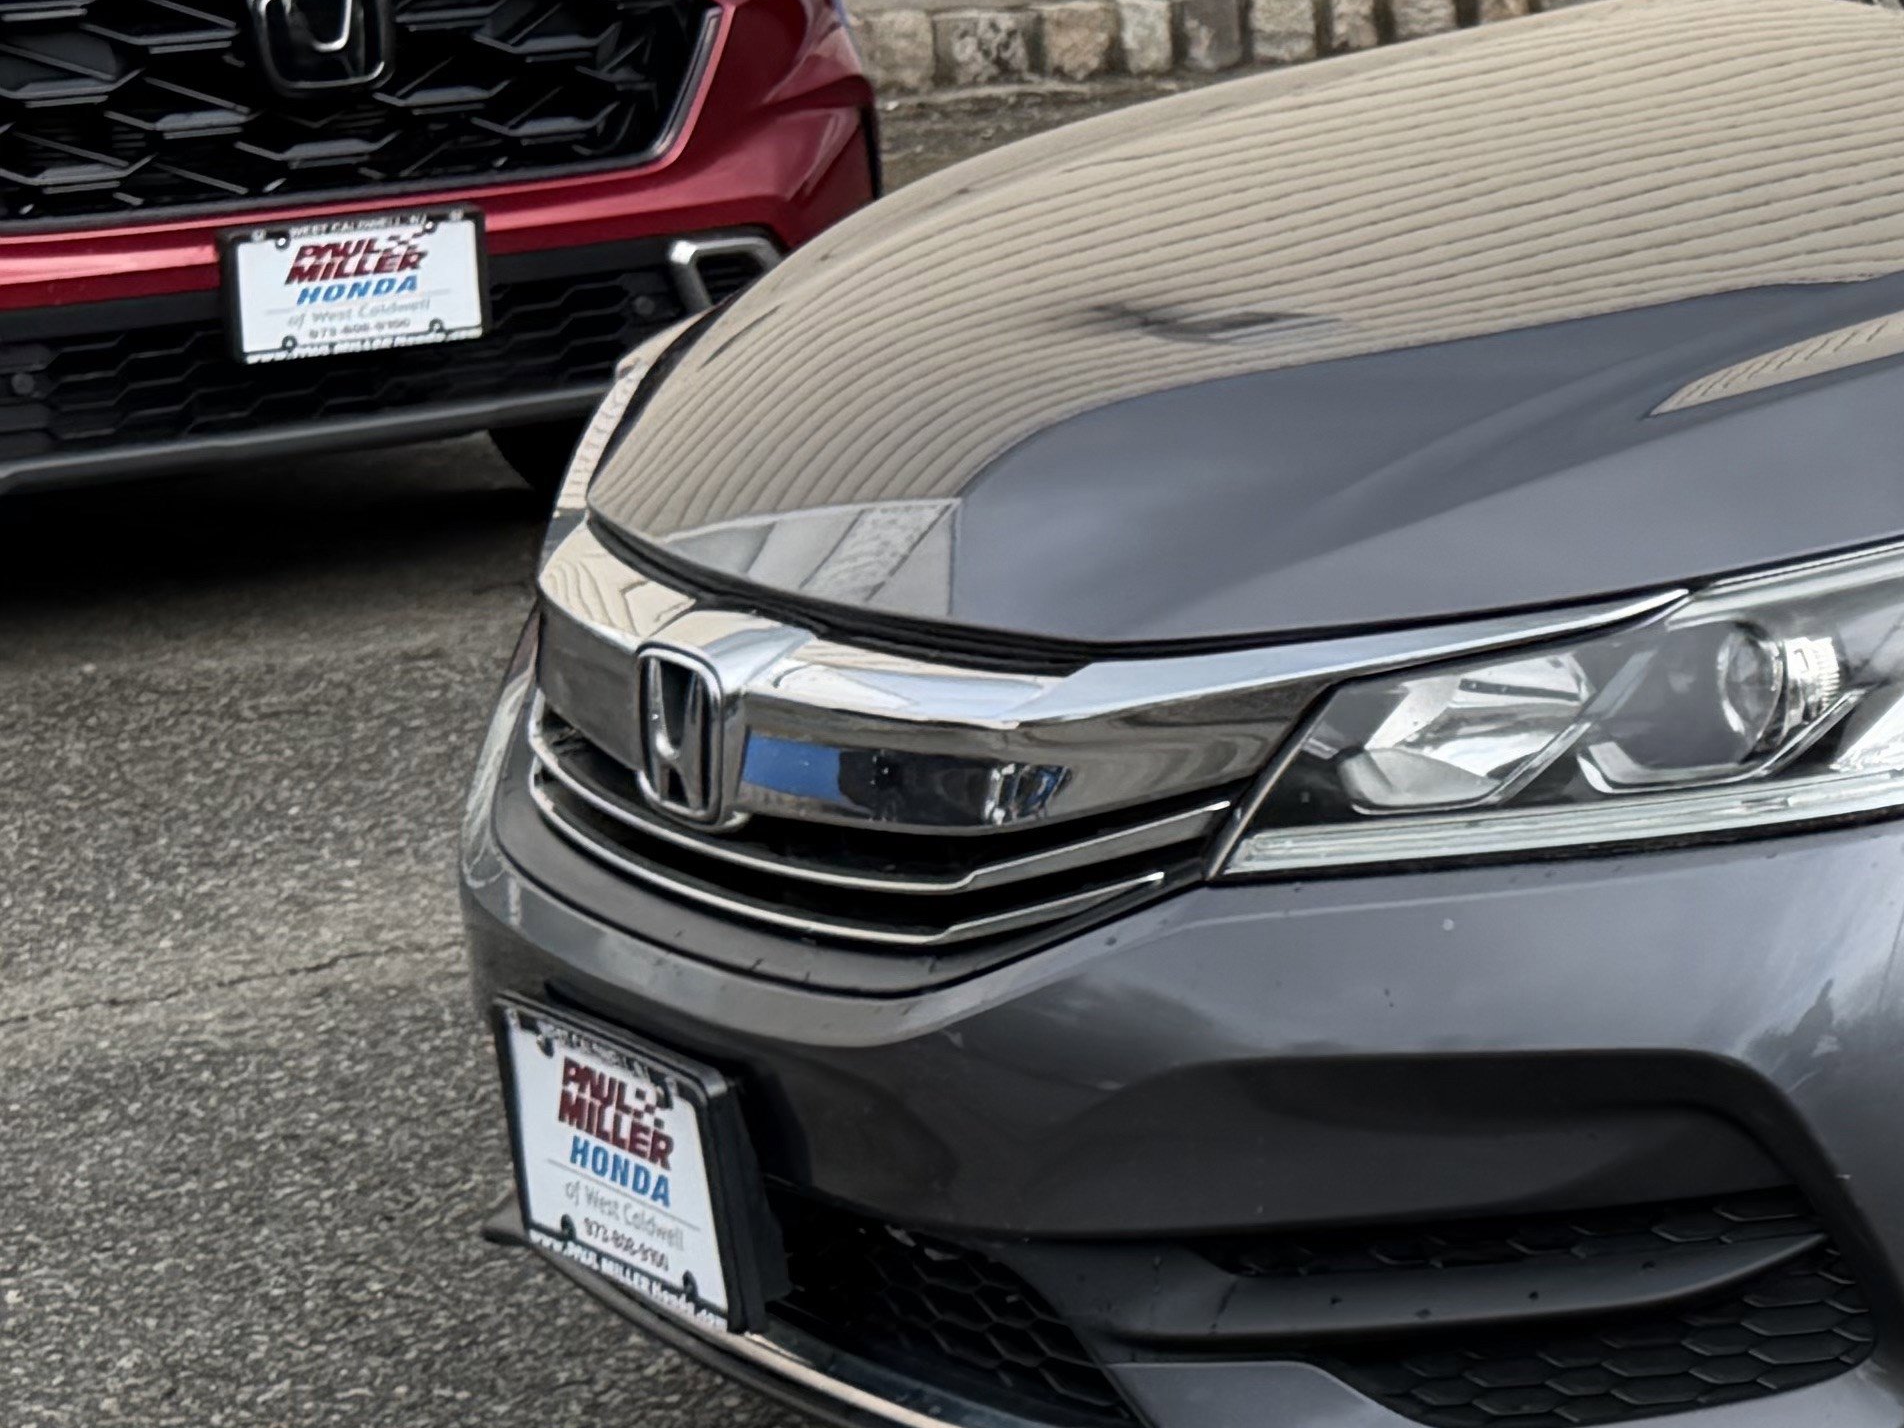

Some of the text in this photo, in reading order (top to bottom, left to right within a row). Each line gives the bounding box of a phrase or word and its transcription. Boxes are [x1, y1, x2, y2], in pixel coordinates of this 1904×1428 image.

[285, 245, 428, 285] MILLER
[296, 238, 380, 264] PAUL
[297, 275, 418, 306] HONDA
[562, 1056, 632, 1114] PAUL
[558, 1087, 674, 1171] MILLER
[569, 1135, 671, 1208] HONDA
